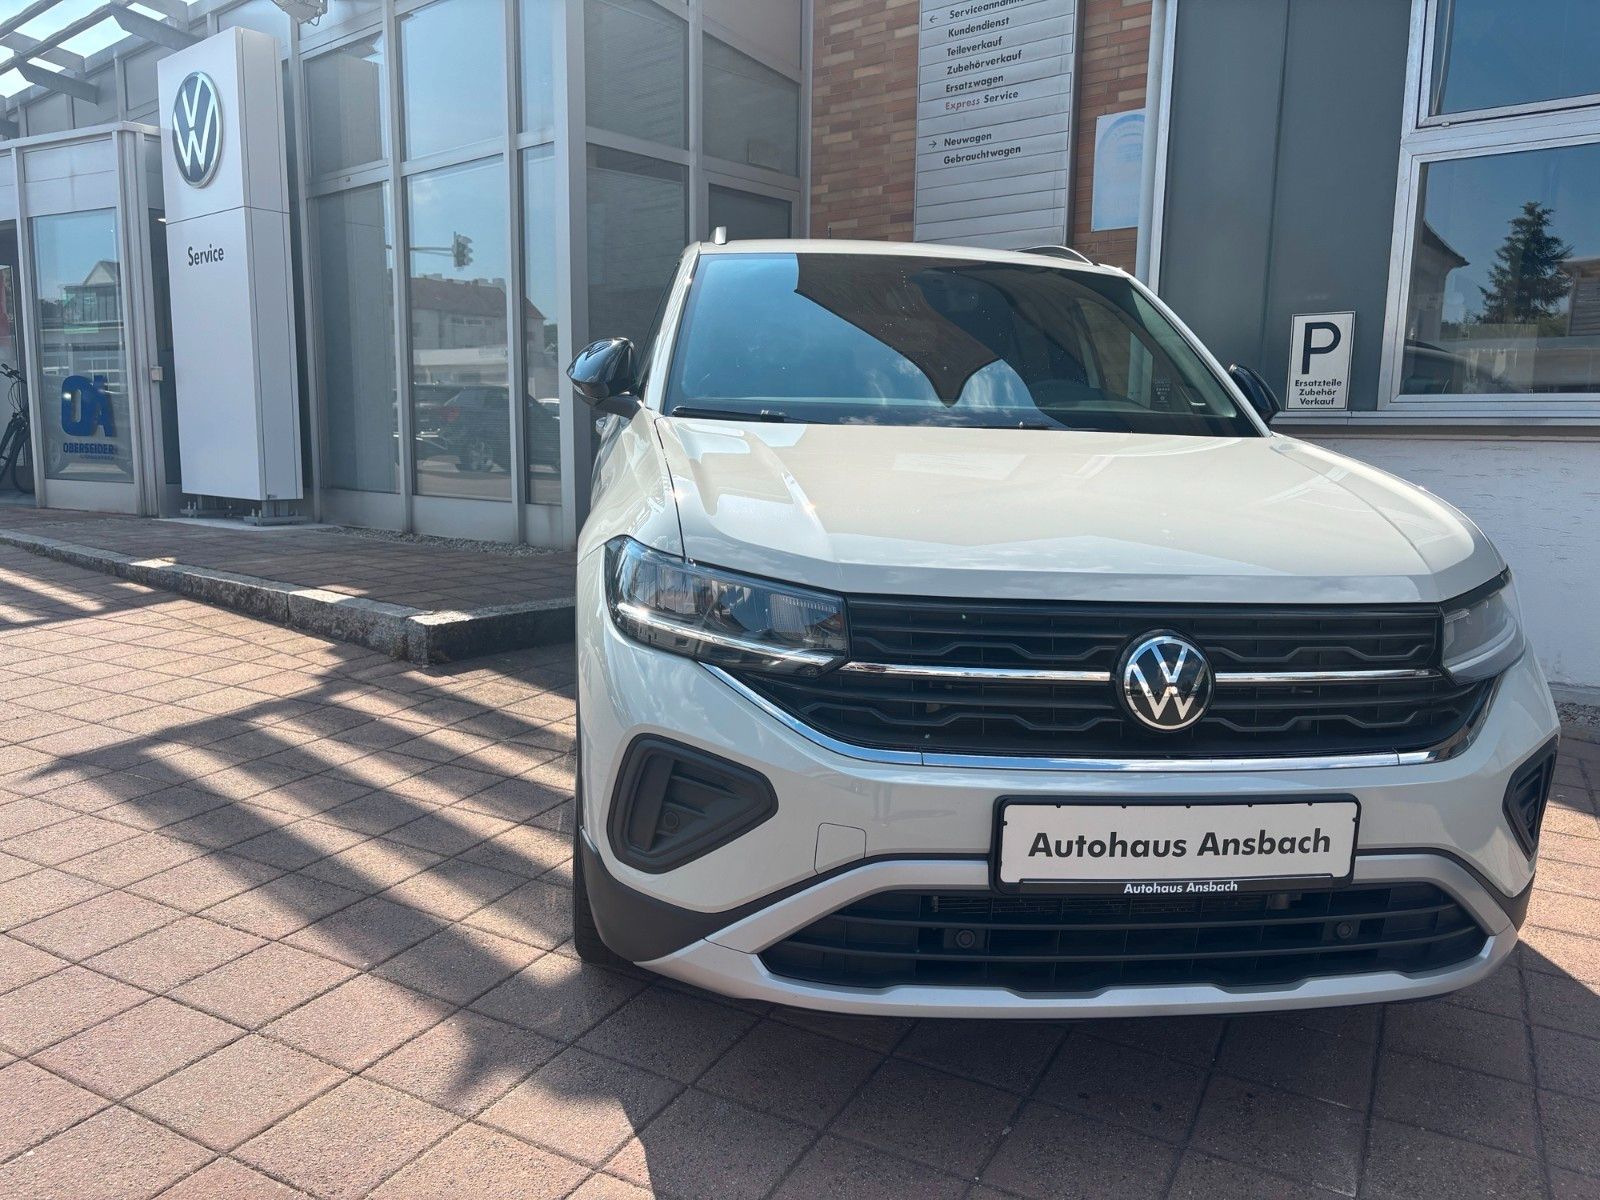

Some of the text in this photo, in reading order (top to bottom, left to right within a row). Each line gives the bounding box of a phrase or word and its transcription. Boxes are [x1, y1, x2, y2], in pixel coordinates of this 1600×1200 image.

[949, 0, 1024, 19] Serviceanna
[948, 16, 1010, 38] Kundendienst
[946, 36, 1002, 57] Teileverkauf
[946, 50, 1022, 75] Zubehörverkauf
[945, 74, 1004, 93] Ersatzwagen
[945, 90, 1018, 111] Express Service
[944, 132, 992, 147] Neuwagen
[943, 146, 1021, 165] Gebrauchtwagen
[187, 244, 224, 266] Service
[1301, 322, 1341, 375] P
[1295, 379, 1342, 387] Ersatzteile
[1299, 388, 1336, 396] Zubehör
[1028, 828, 1331, 859] Autohaus Ansbach
[1123, 881, 1238, 895] Autohaus Ansbach
